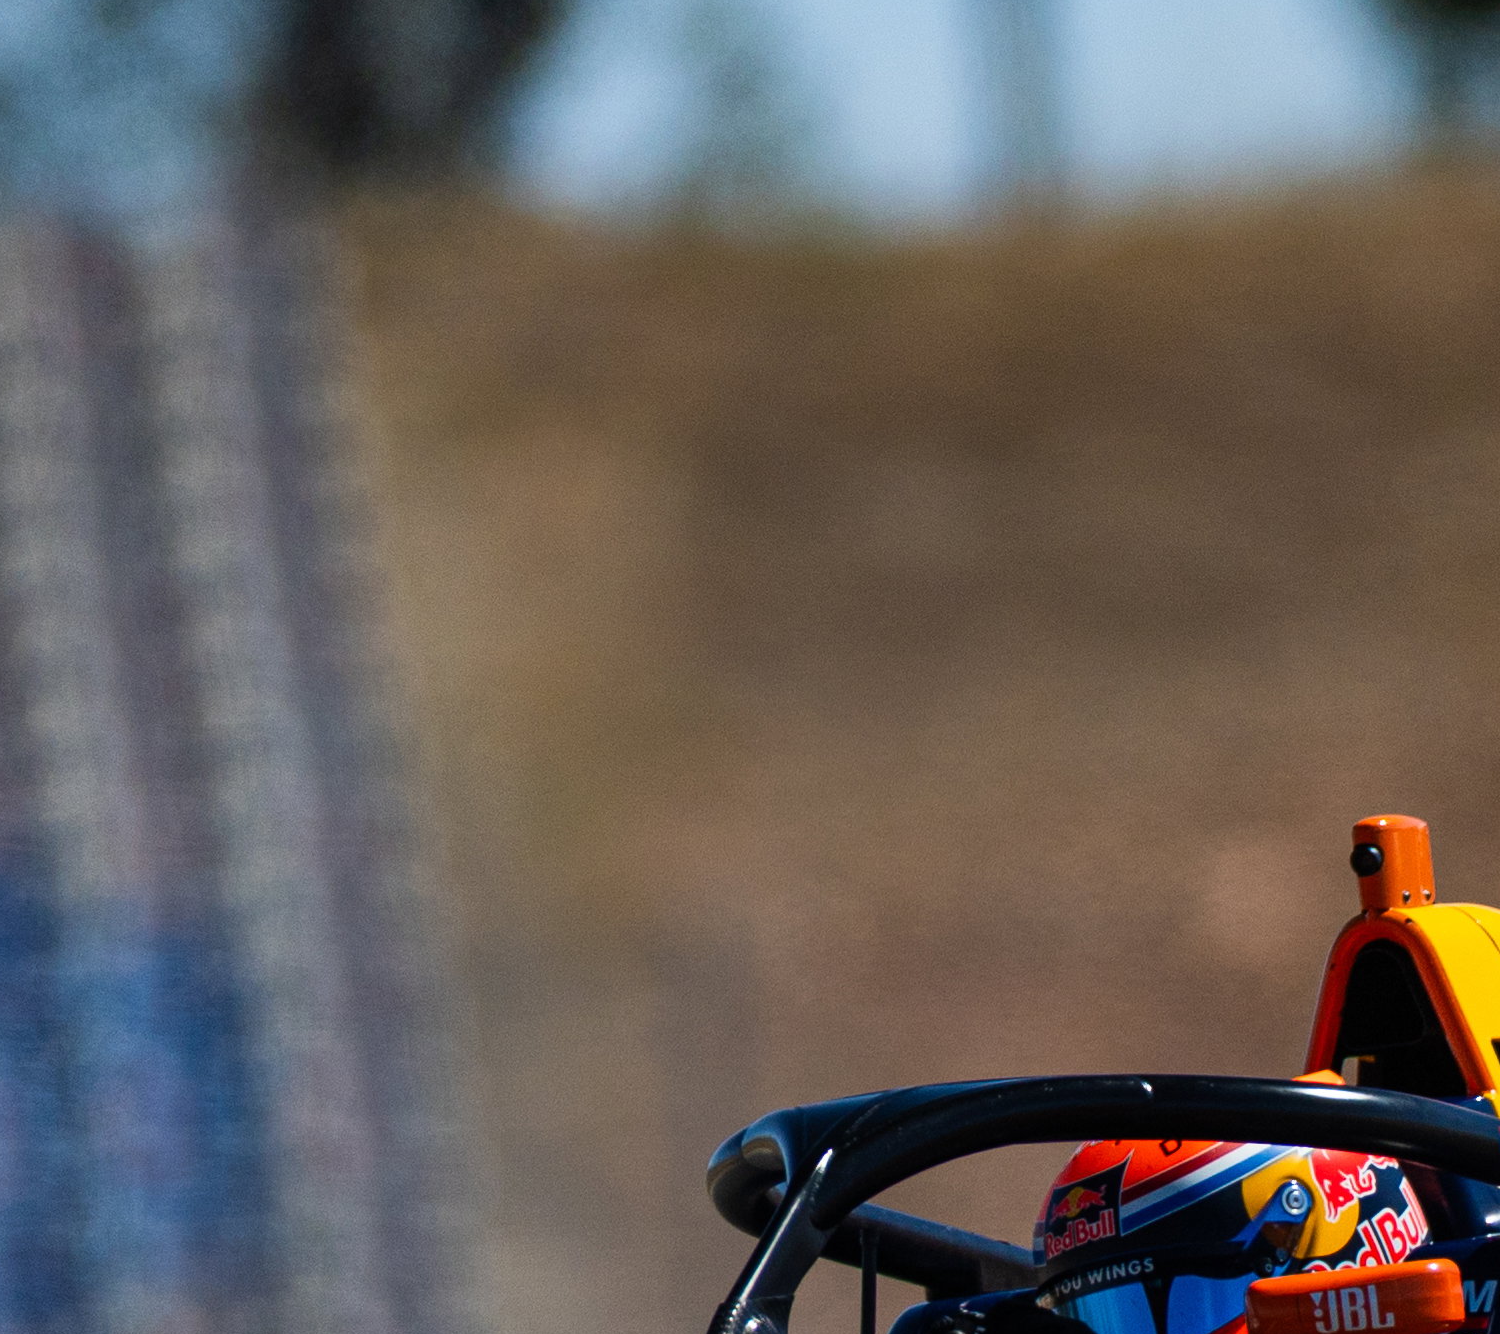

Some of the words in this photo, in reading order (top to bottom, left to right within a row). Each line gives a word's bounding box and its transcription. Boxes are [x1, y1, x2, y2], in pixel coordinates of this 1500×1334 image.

[1074, 1208, 1116, 1245] Bull
[1088, 1257, 1155, 1285] WINGS
[1310, 1284, 1395, 1334] JBL
